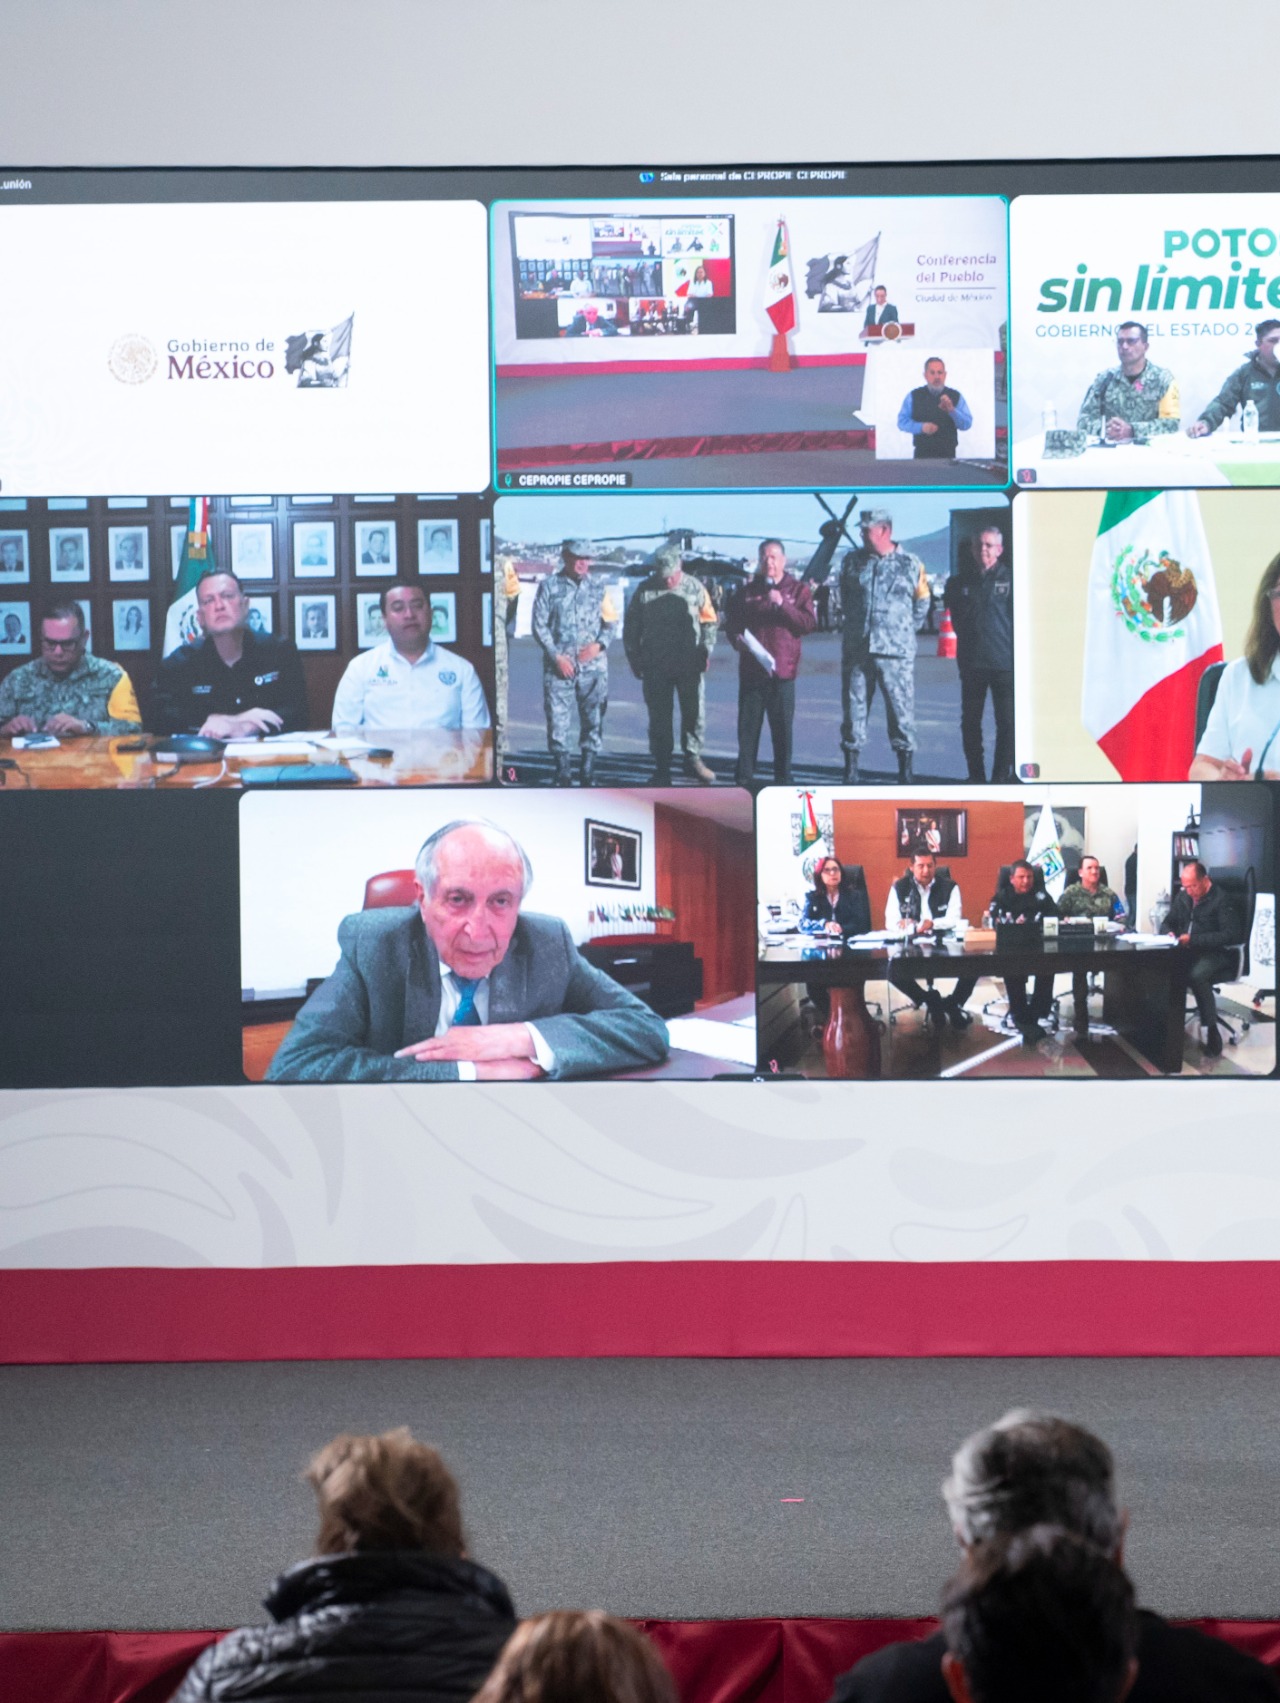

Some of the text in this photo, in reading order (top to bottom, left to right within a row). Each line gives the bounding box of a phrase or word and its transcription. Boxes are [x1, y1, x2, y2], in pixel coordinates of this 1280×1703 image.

[916, 253, 997, 266] Conferencia
[916, 270, 985, 283] del Pueblo
[1036, 262, 1123, 313] sin
[1035, 323, 1120, 338] GOBIERN
[1170, 322, 1239, 337] ESTADO
[167, 338, 275, 353] Gobierno de
[167, 355, 275, 380] México
[518, 473, 626, 486] CEPROPIE CEPROPIE
